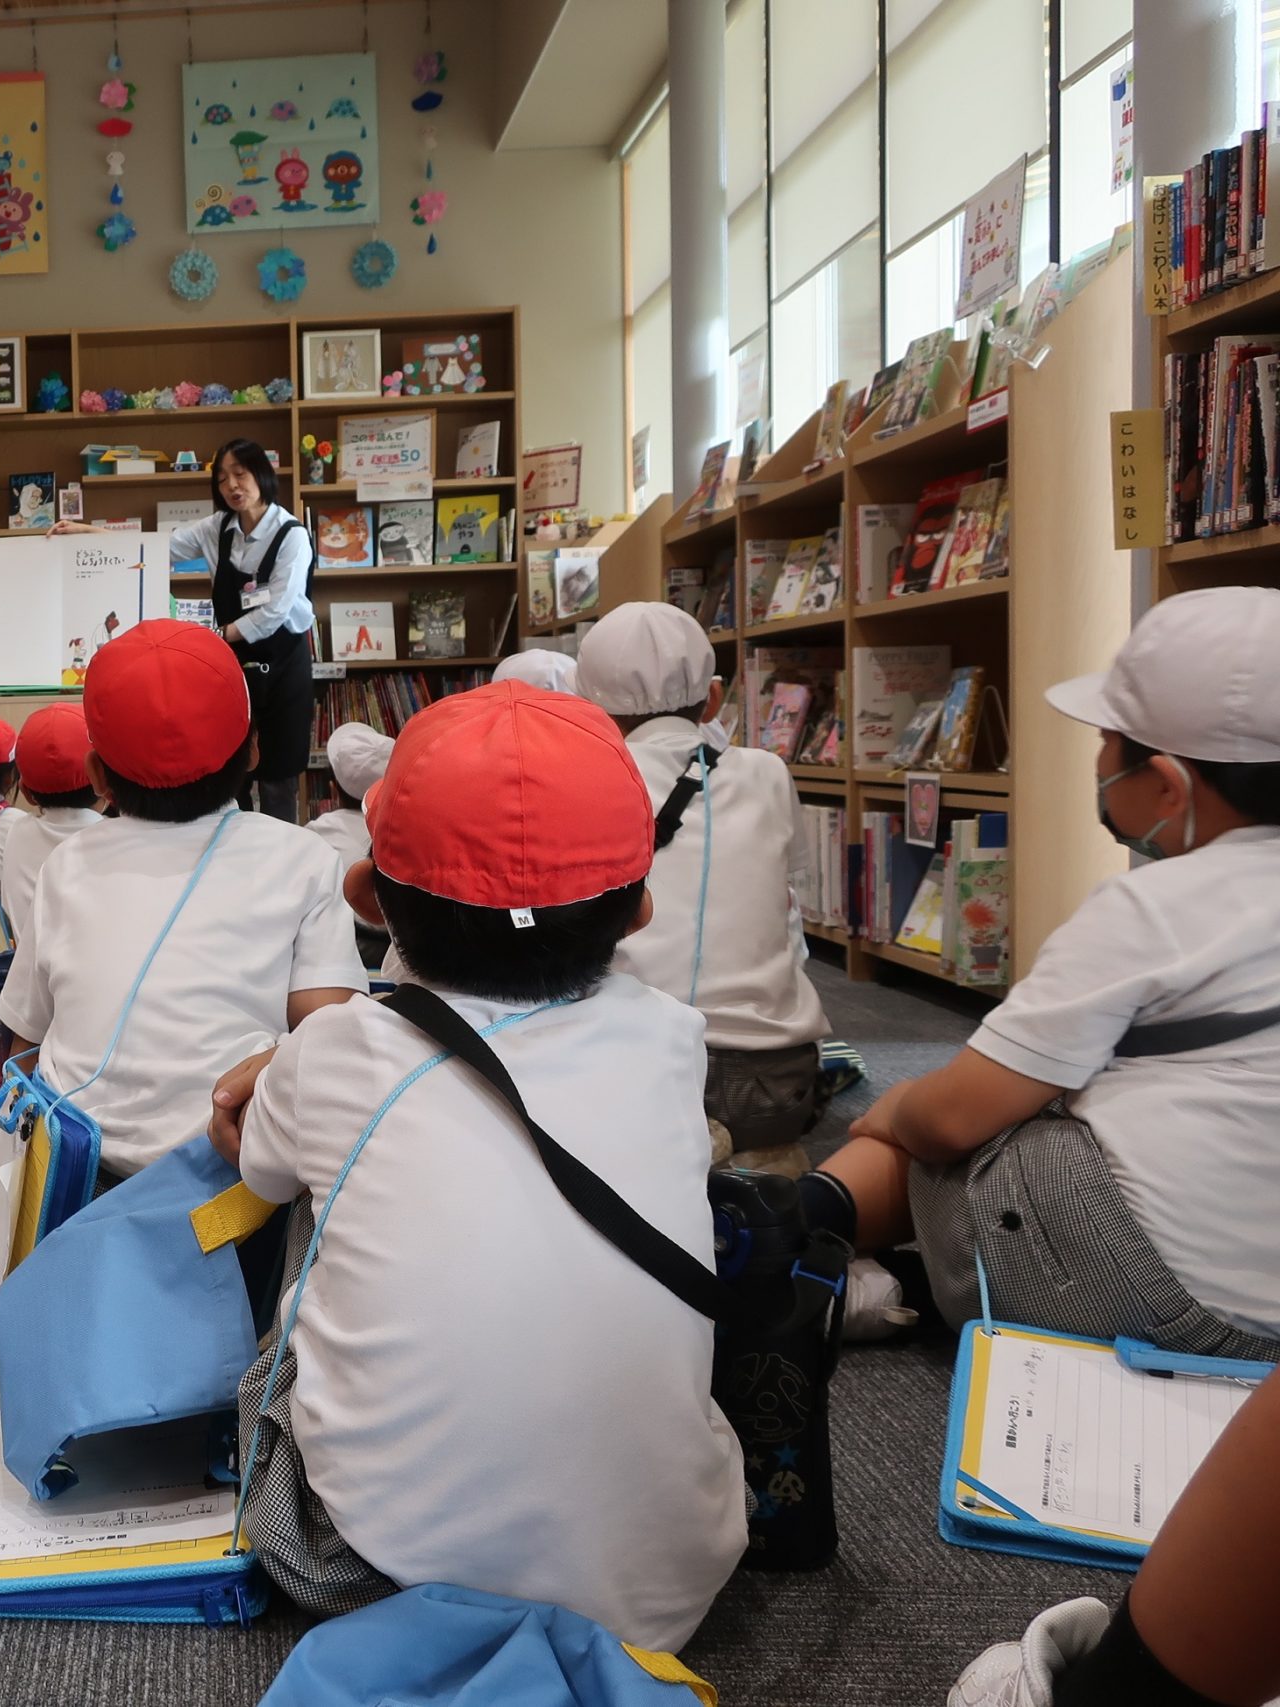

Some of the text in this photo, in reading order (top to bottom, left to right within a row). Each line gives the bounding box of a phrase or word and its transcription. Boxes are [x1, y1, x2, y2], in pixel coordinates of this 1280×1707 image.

[400, 449, 421, 463] 50
[1120, 421, 1139, 541] こわいはなし
[517, 915, 530, 926] M
